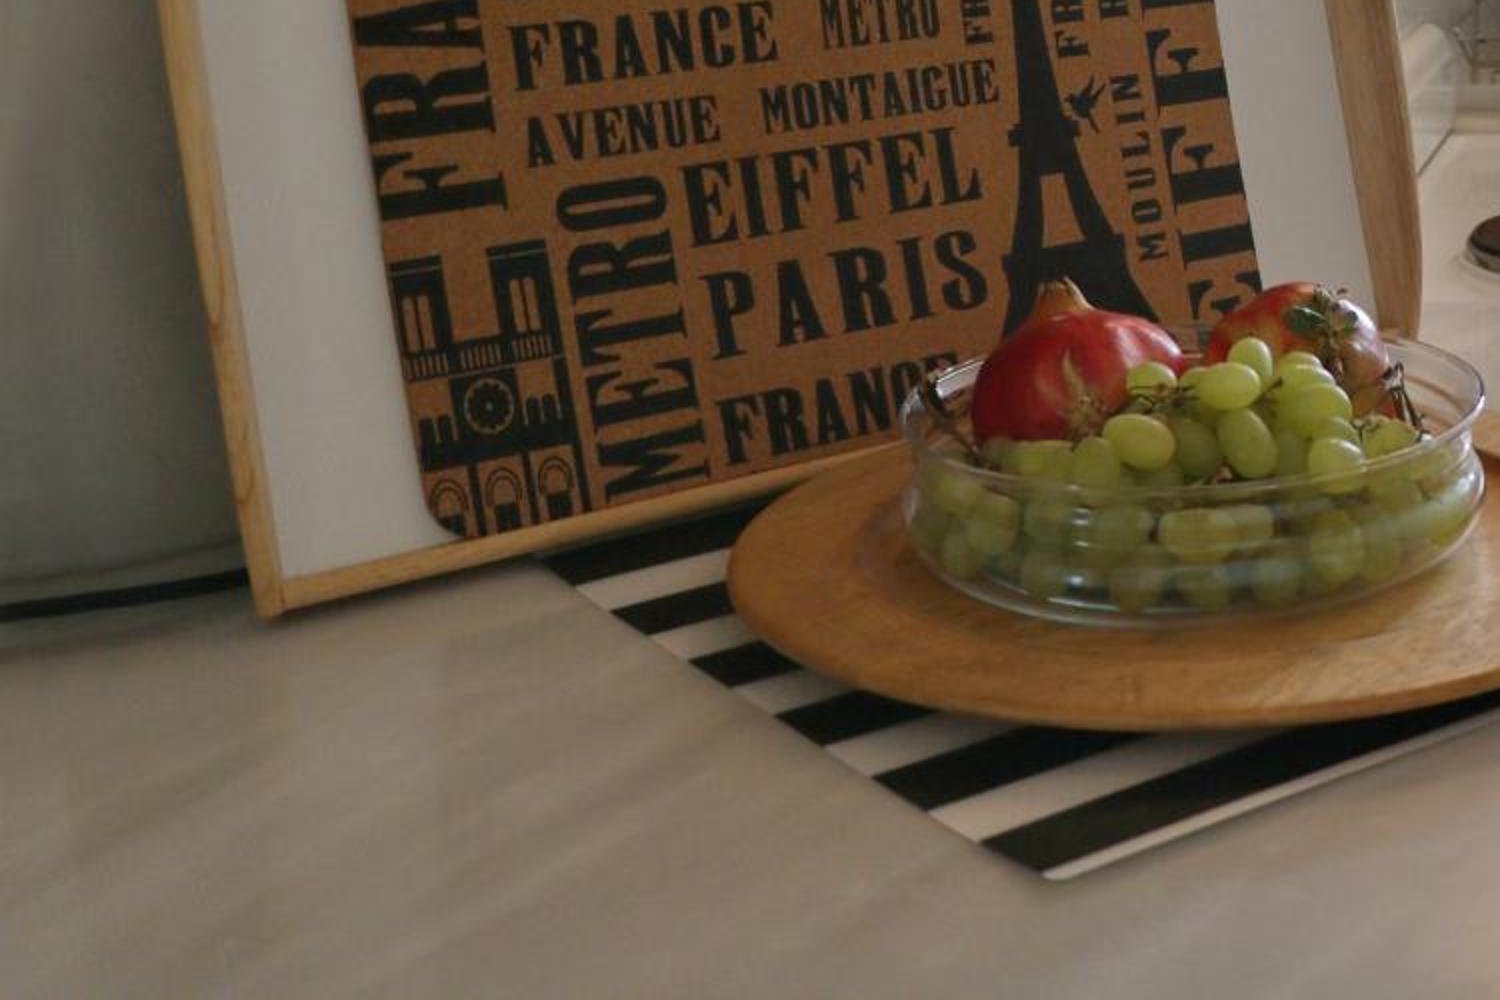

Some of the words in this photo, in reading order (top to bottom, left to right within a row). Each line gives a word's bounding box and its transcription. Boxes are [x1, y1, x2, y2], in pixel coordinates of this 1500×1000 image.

[507, 1, 779, 92] FRANCE
[527, 95, 721, 168] AVENUE
[758, 59, 1000, 135] MONTAIGUE
[1109, 73, 1169, 263] MOULIN
[681, 127, 983, 248] EIFFEL
[555, 175, 711, 503] METRO
[699, 230, 989, 360] PARIS
